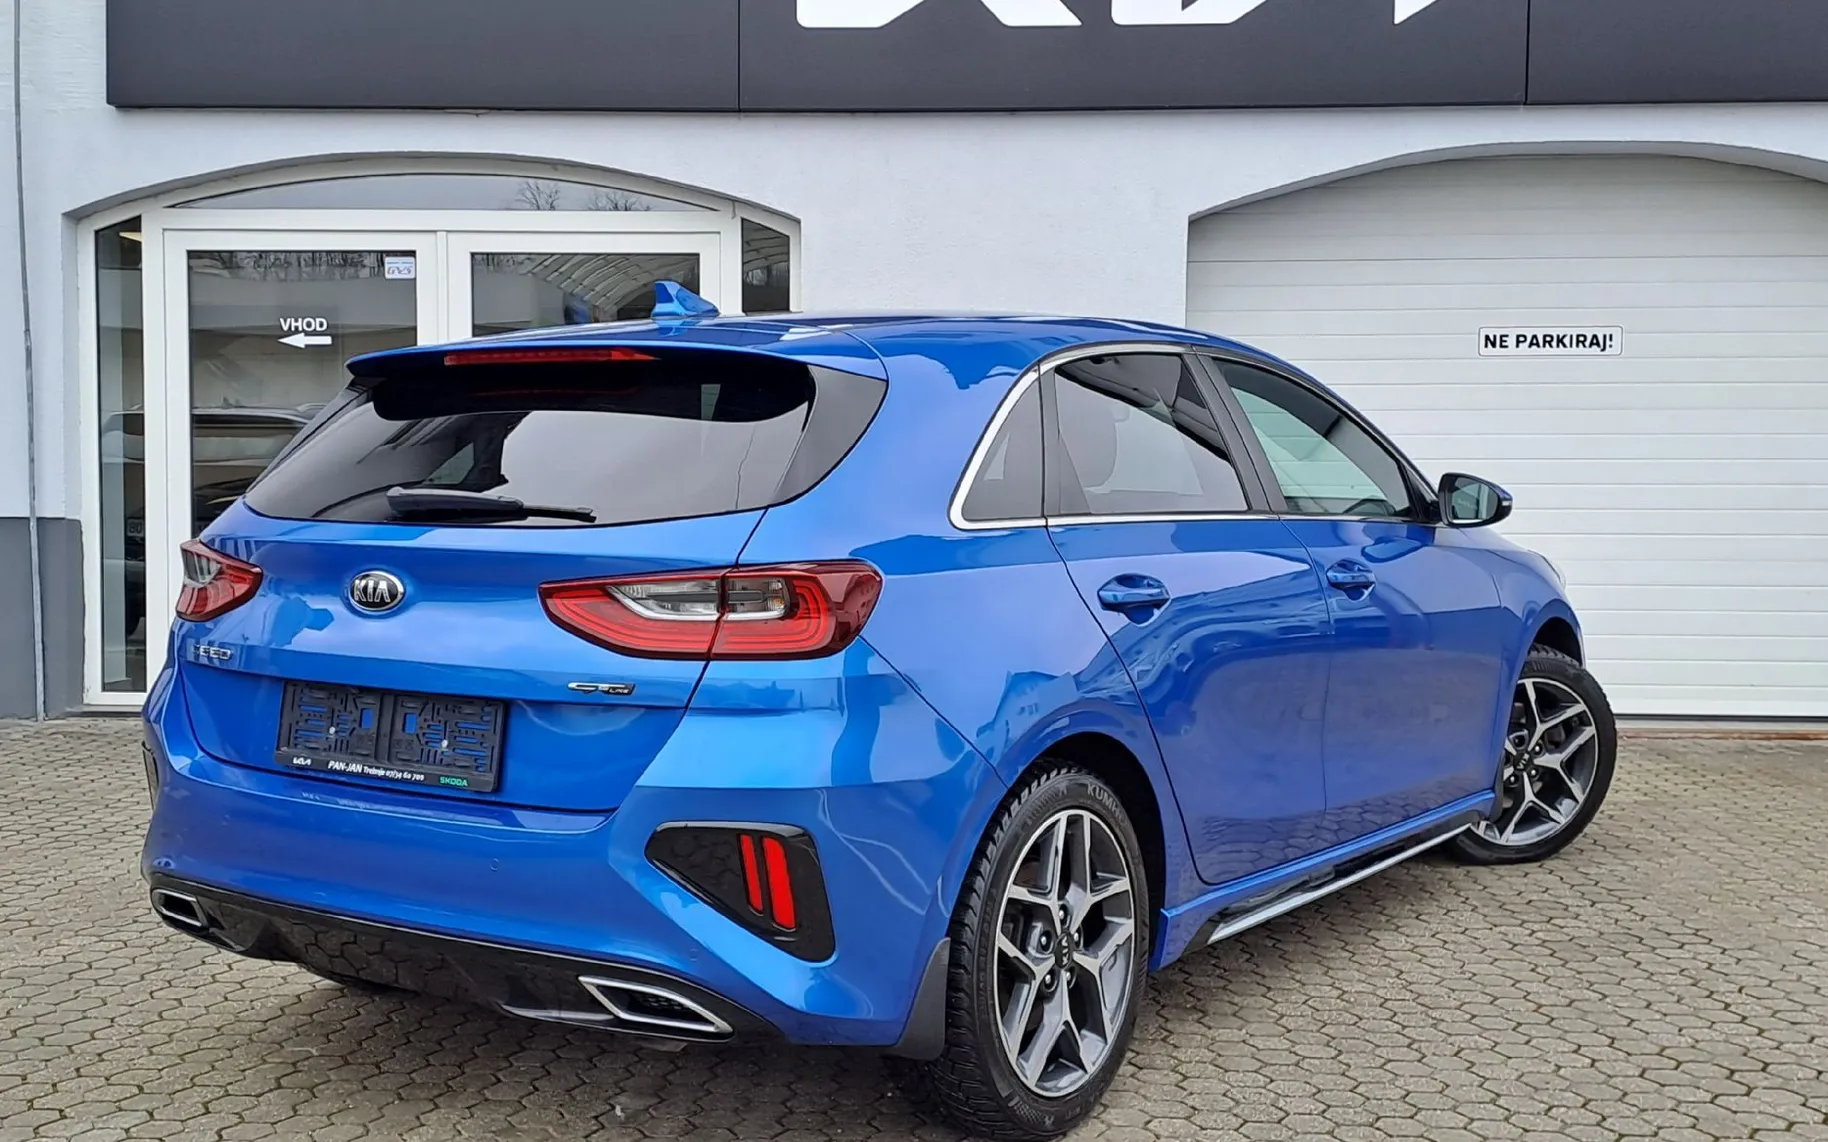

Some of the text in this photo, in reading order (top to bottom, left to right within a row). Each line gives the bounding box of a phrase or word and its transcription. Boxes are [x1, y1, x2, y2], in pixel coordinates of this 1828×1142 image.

[280, 318, 327, 331] VHOD
[1484, 333, 1613, 352] NE PARKIRAJ!
[353, 579, 391, 602] KIA
[328, 760, 363, 773] PAN-JAN
